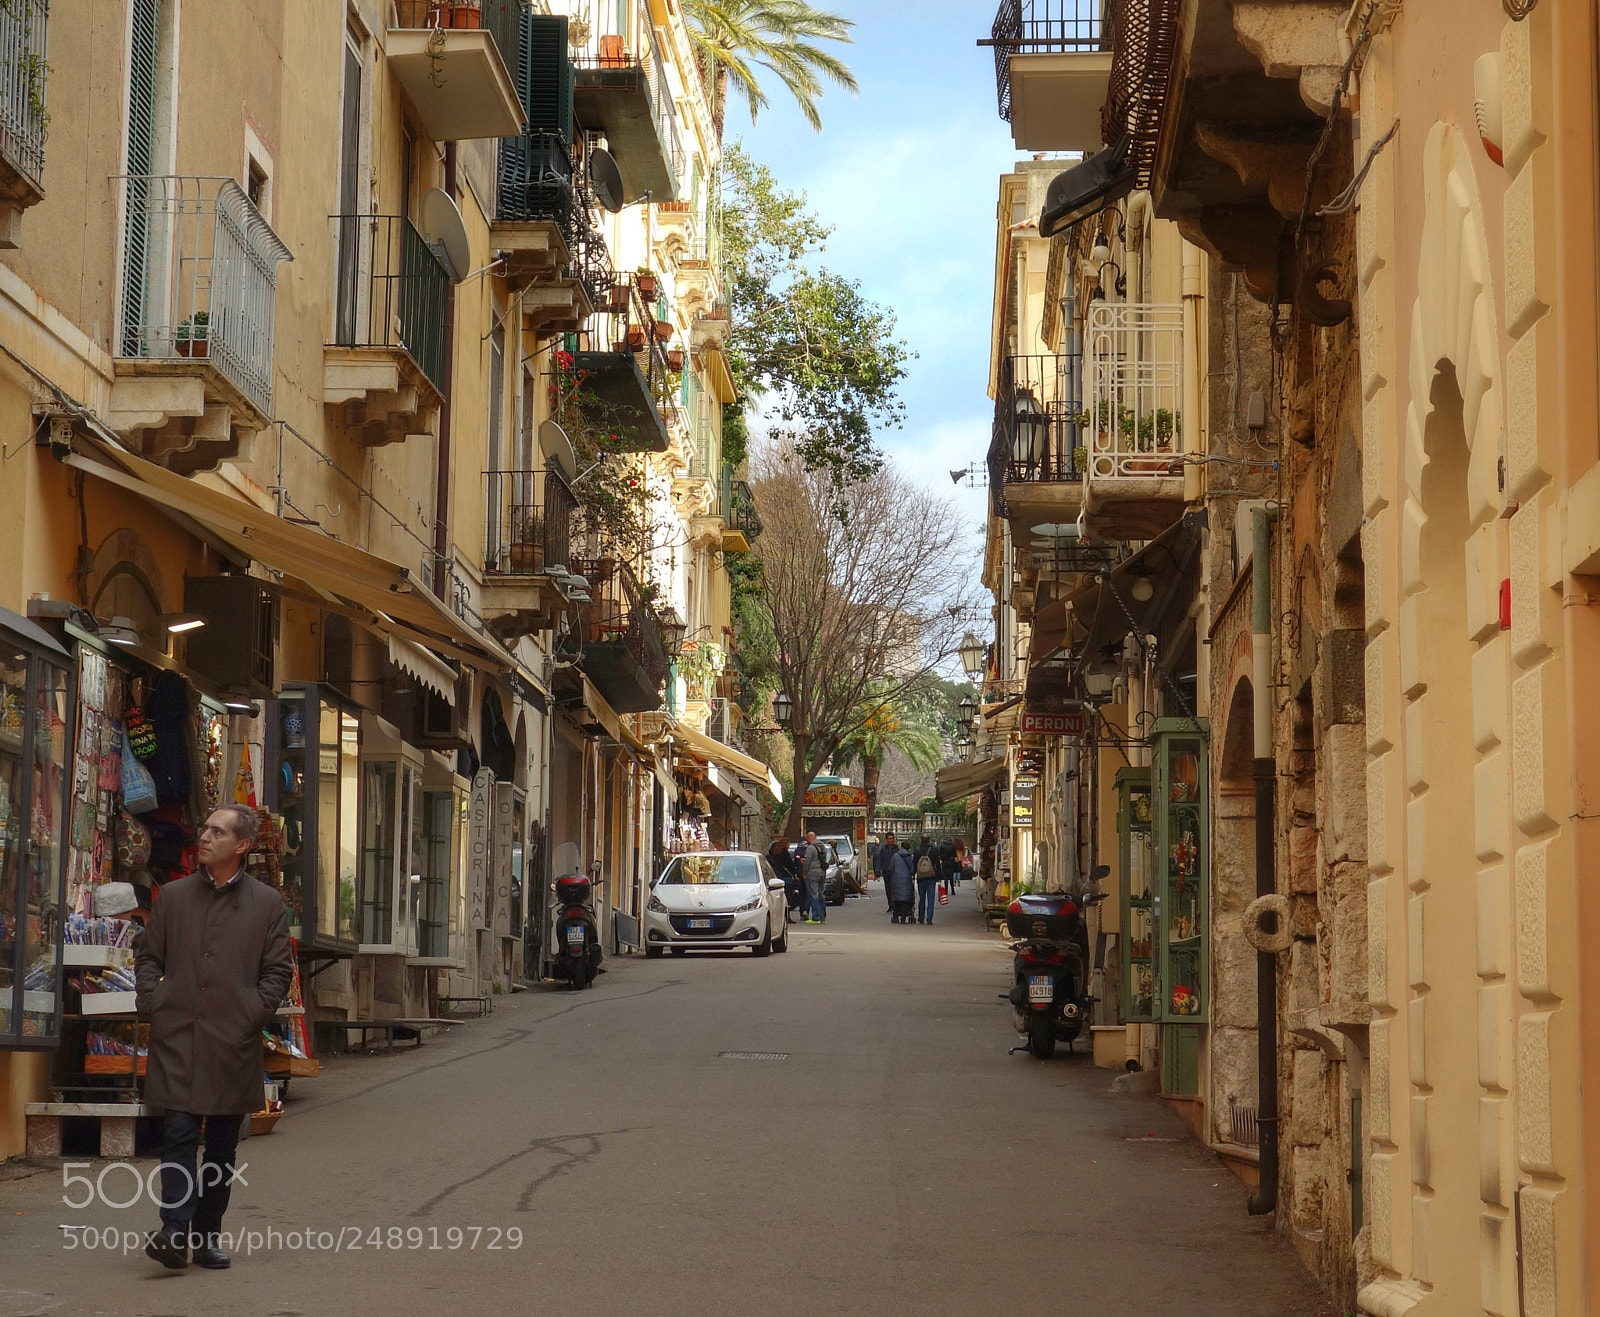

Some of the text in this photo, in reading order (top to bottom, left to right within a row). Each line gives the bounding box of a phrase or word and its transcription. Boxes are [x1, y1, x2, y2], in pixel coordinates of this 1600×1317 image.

[1025, 716, 1080, 730] PERONI
[813, 787, 855, 798] Orange Juice
[471, 775, 486, 921] CASTORINA
[497, 802, 511, 919] OTTICA
